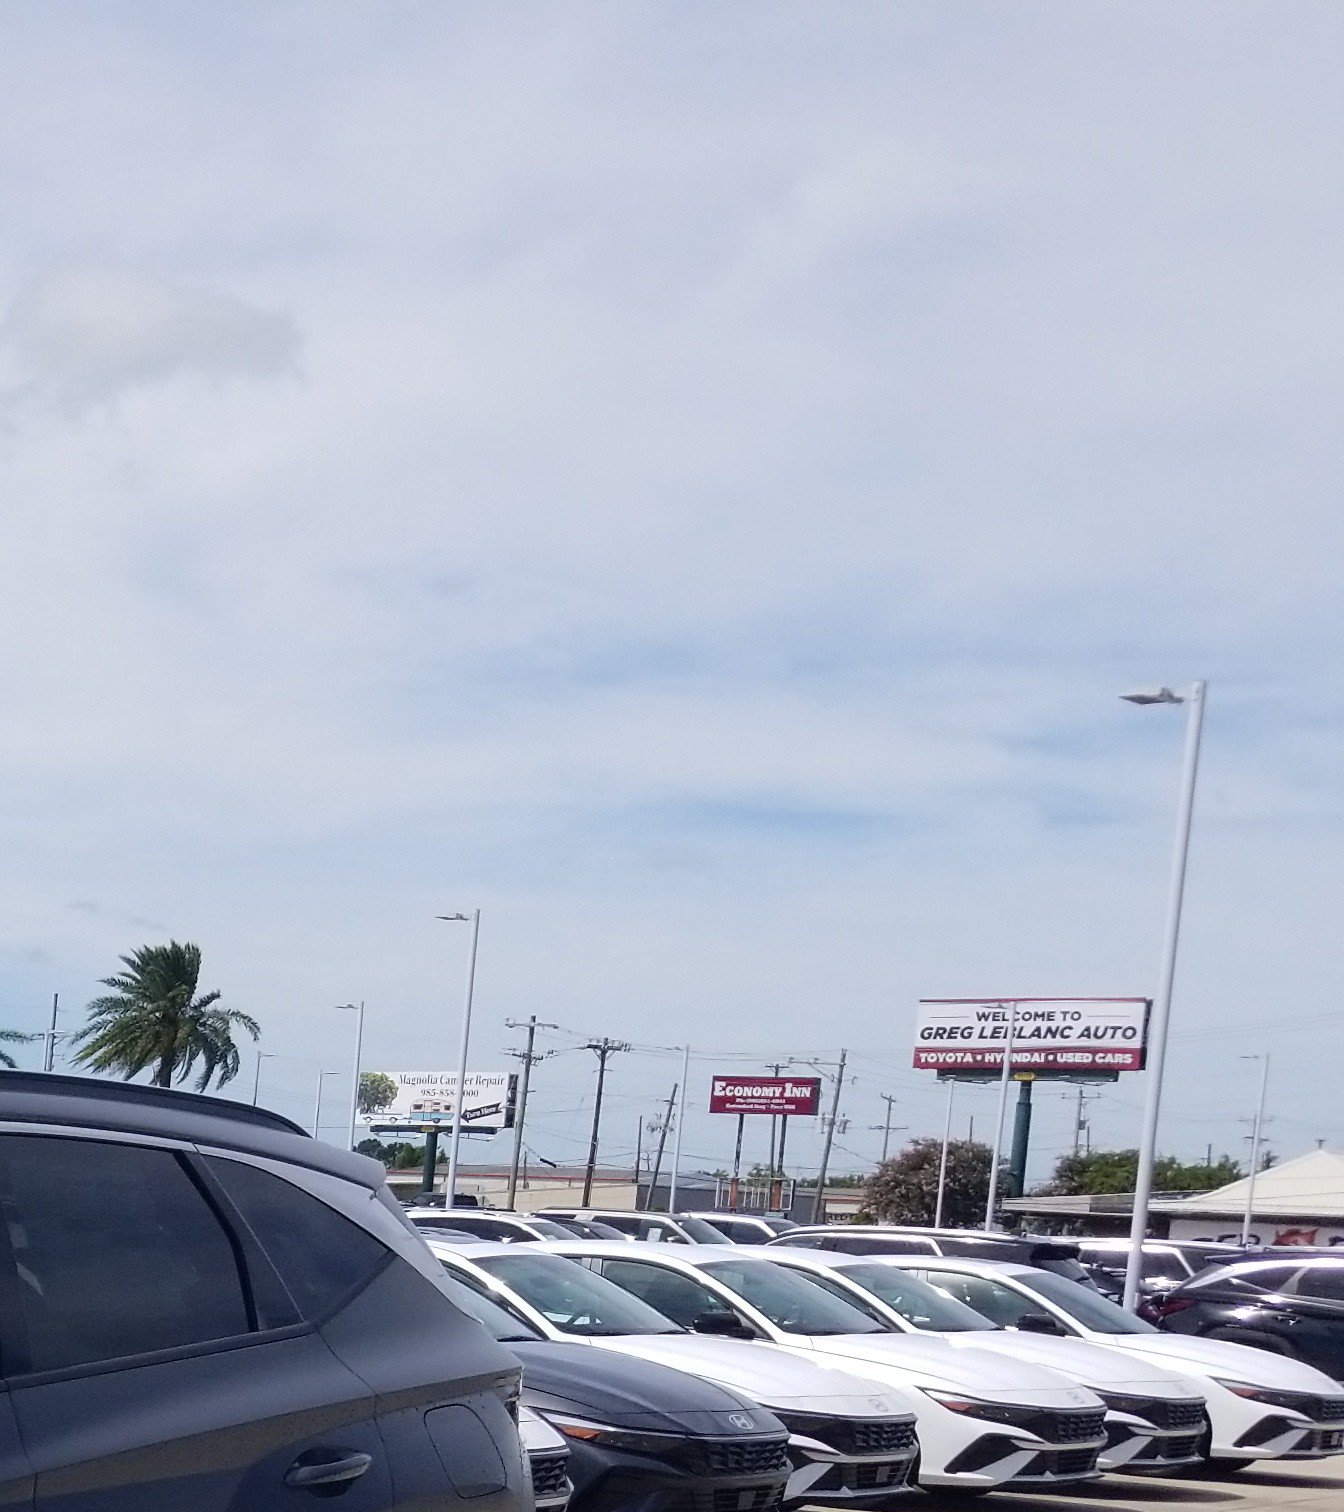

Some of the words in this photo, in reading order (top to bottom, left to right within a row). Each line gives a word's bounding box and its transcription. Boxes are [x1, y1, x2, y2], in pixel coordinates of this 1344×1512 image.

[976, 1011, 1056, 1022] WELCOME
[1060, 1011, 1082, 1021] TO
[920, 1026, 975, 1040] GREG
[977, 1026, 1073, 1040] LEBLANC
[1076, 1026, 1137, 1040] AUTO
[919, 1052, 973, 1063] TOYOTA
[984, 1052, 1045, 1063] HYNDAI
[1056, 1052, 1093, 1063] USED
[1095, 1053, 1133, 1064] CARS
[400, 1074, 438, 1086] Magnolia
[440, 1074, 475, 1085] Camer
[475, 1074, 505, 1088] Repair
[421, 1089, 479, 1097] 985-858-000
